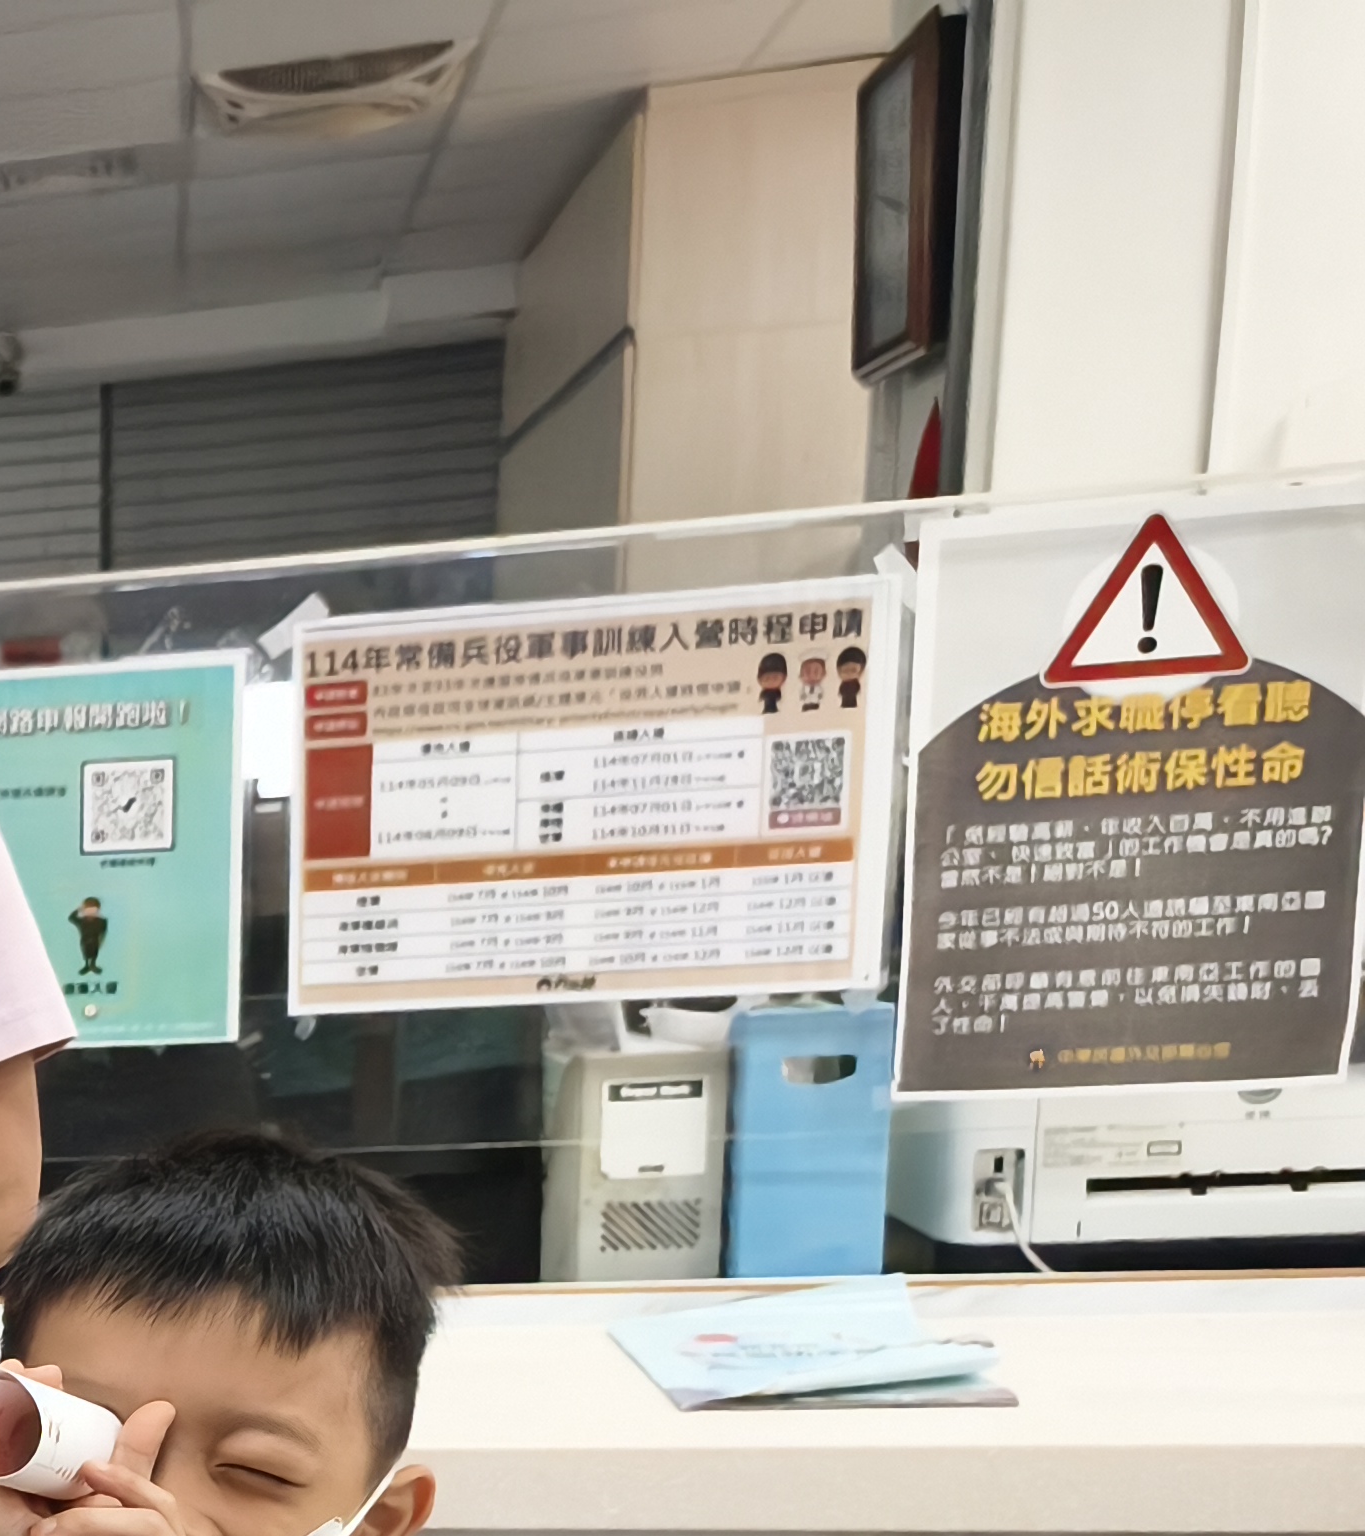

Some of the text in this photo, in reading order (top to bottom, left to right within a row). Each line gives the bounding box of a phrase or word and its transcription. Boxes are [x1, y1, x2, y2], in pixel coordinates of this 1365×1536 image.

[978, 680, 1311, 742] 海外求職停看聽
[976, 741, 1305, 801] 勿信話術保性命
